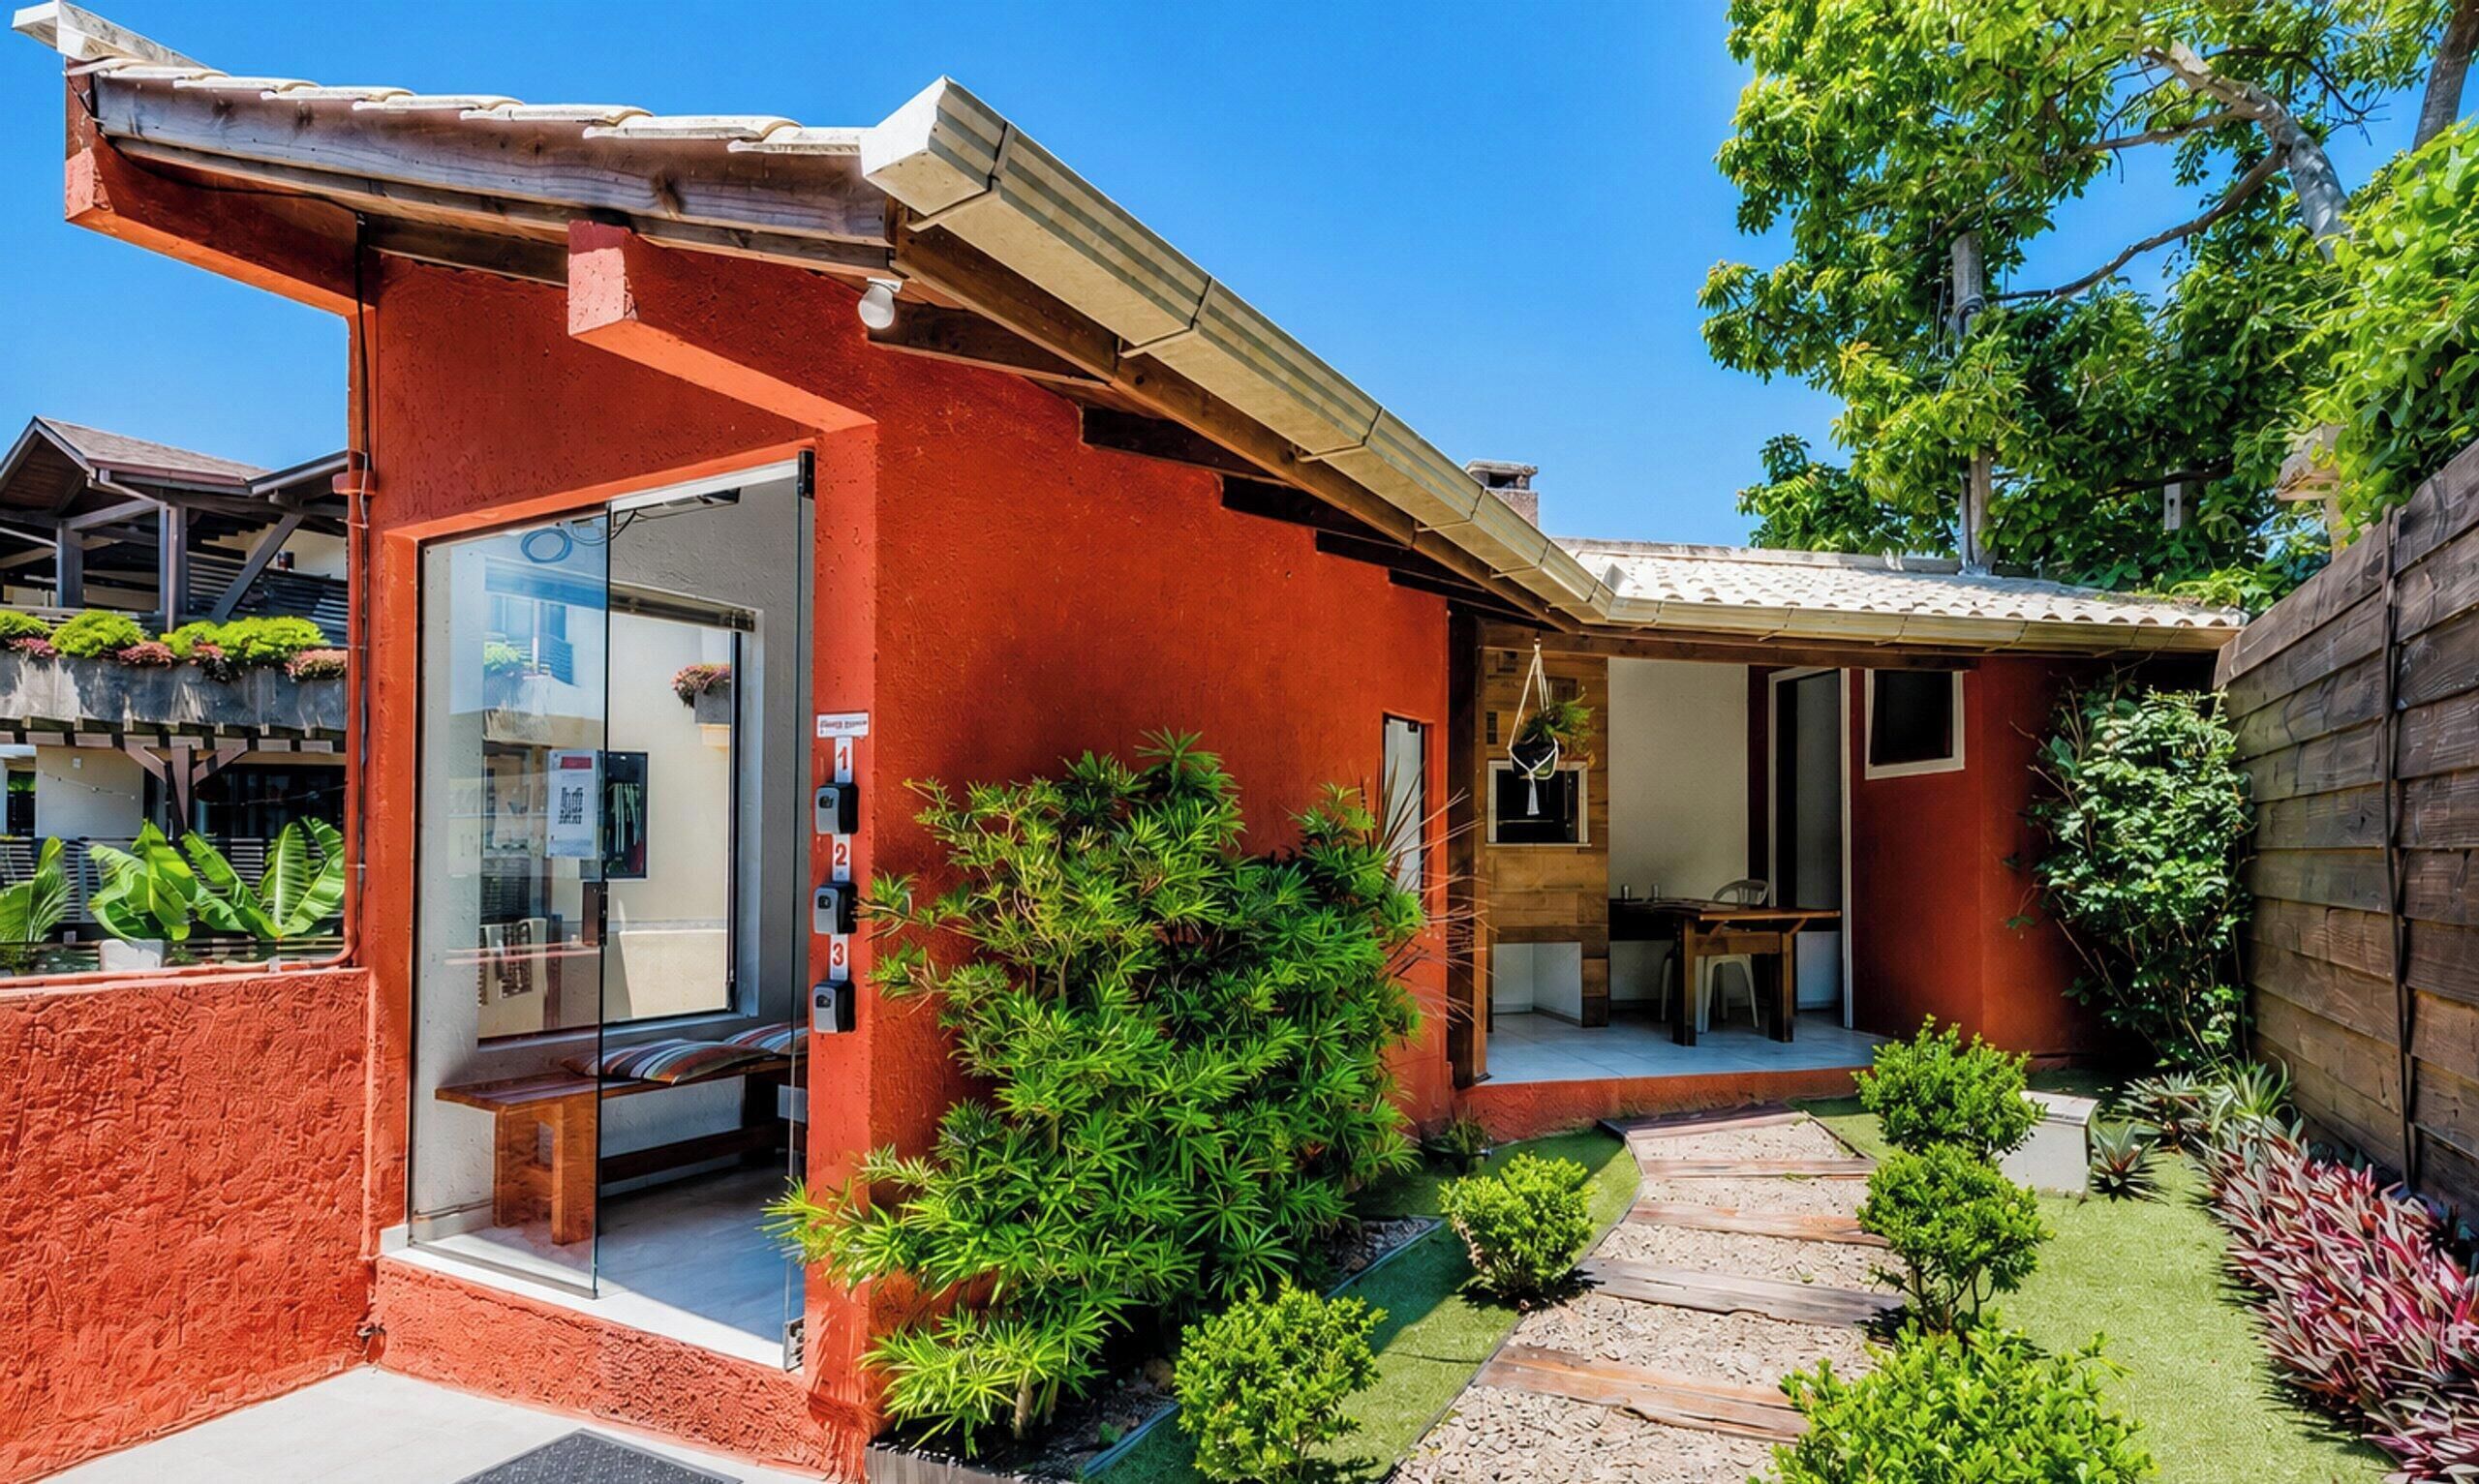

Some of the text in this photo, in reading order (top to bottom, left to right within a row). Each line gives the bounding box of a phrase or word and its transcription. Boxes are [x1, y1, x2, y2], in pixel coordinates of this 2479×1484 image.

[838, 746, 848, 771] 1
[836, 842, 847, 865] 2
[833, 943, 844, 965] 3
